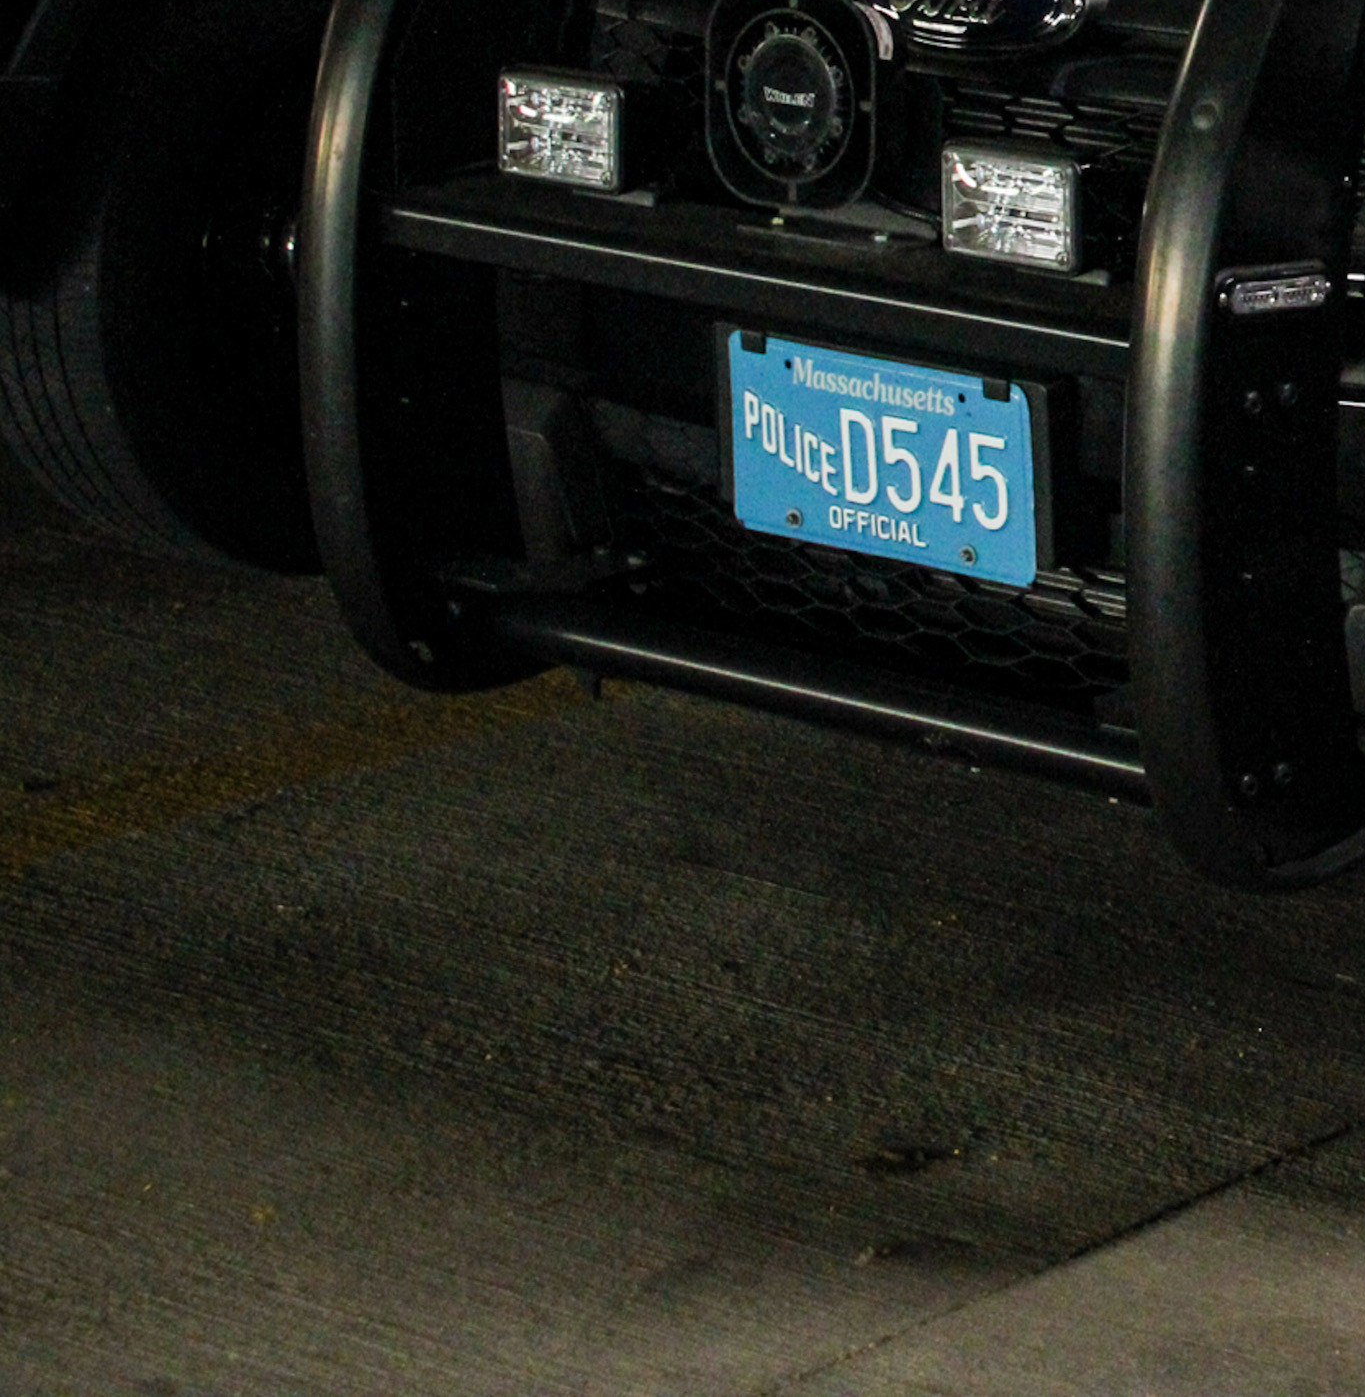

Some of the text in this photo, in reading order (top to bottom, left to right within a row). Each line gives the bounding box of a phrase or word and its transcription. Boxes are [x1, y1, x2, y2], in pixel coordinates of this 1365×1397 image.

[791, 355, 957, 416] Massachusetts
[743, 389, 1009, 532] POLICE D545
[828, 504, 928, 549] OFFICIAL
